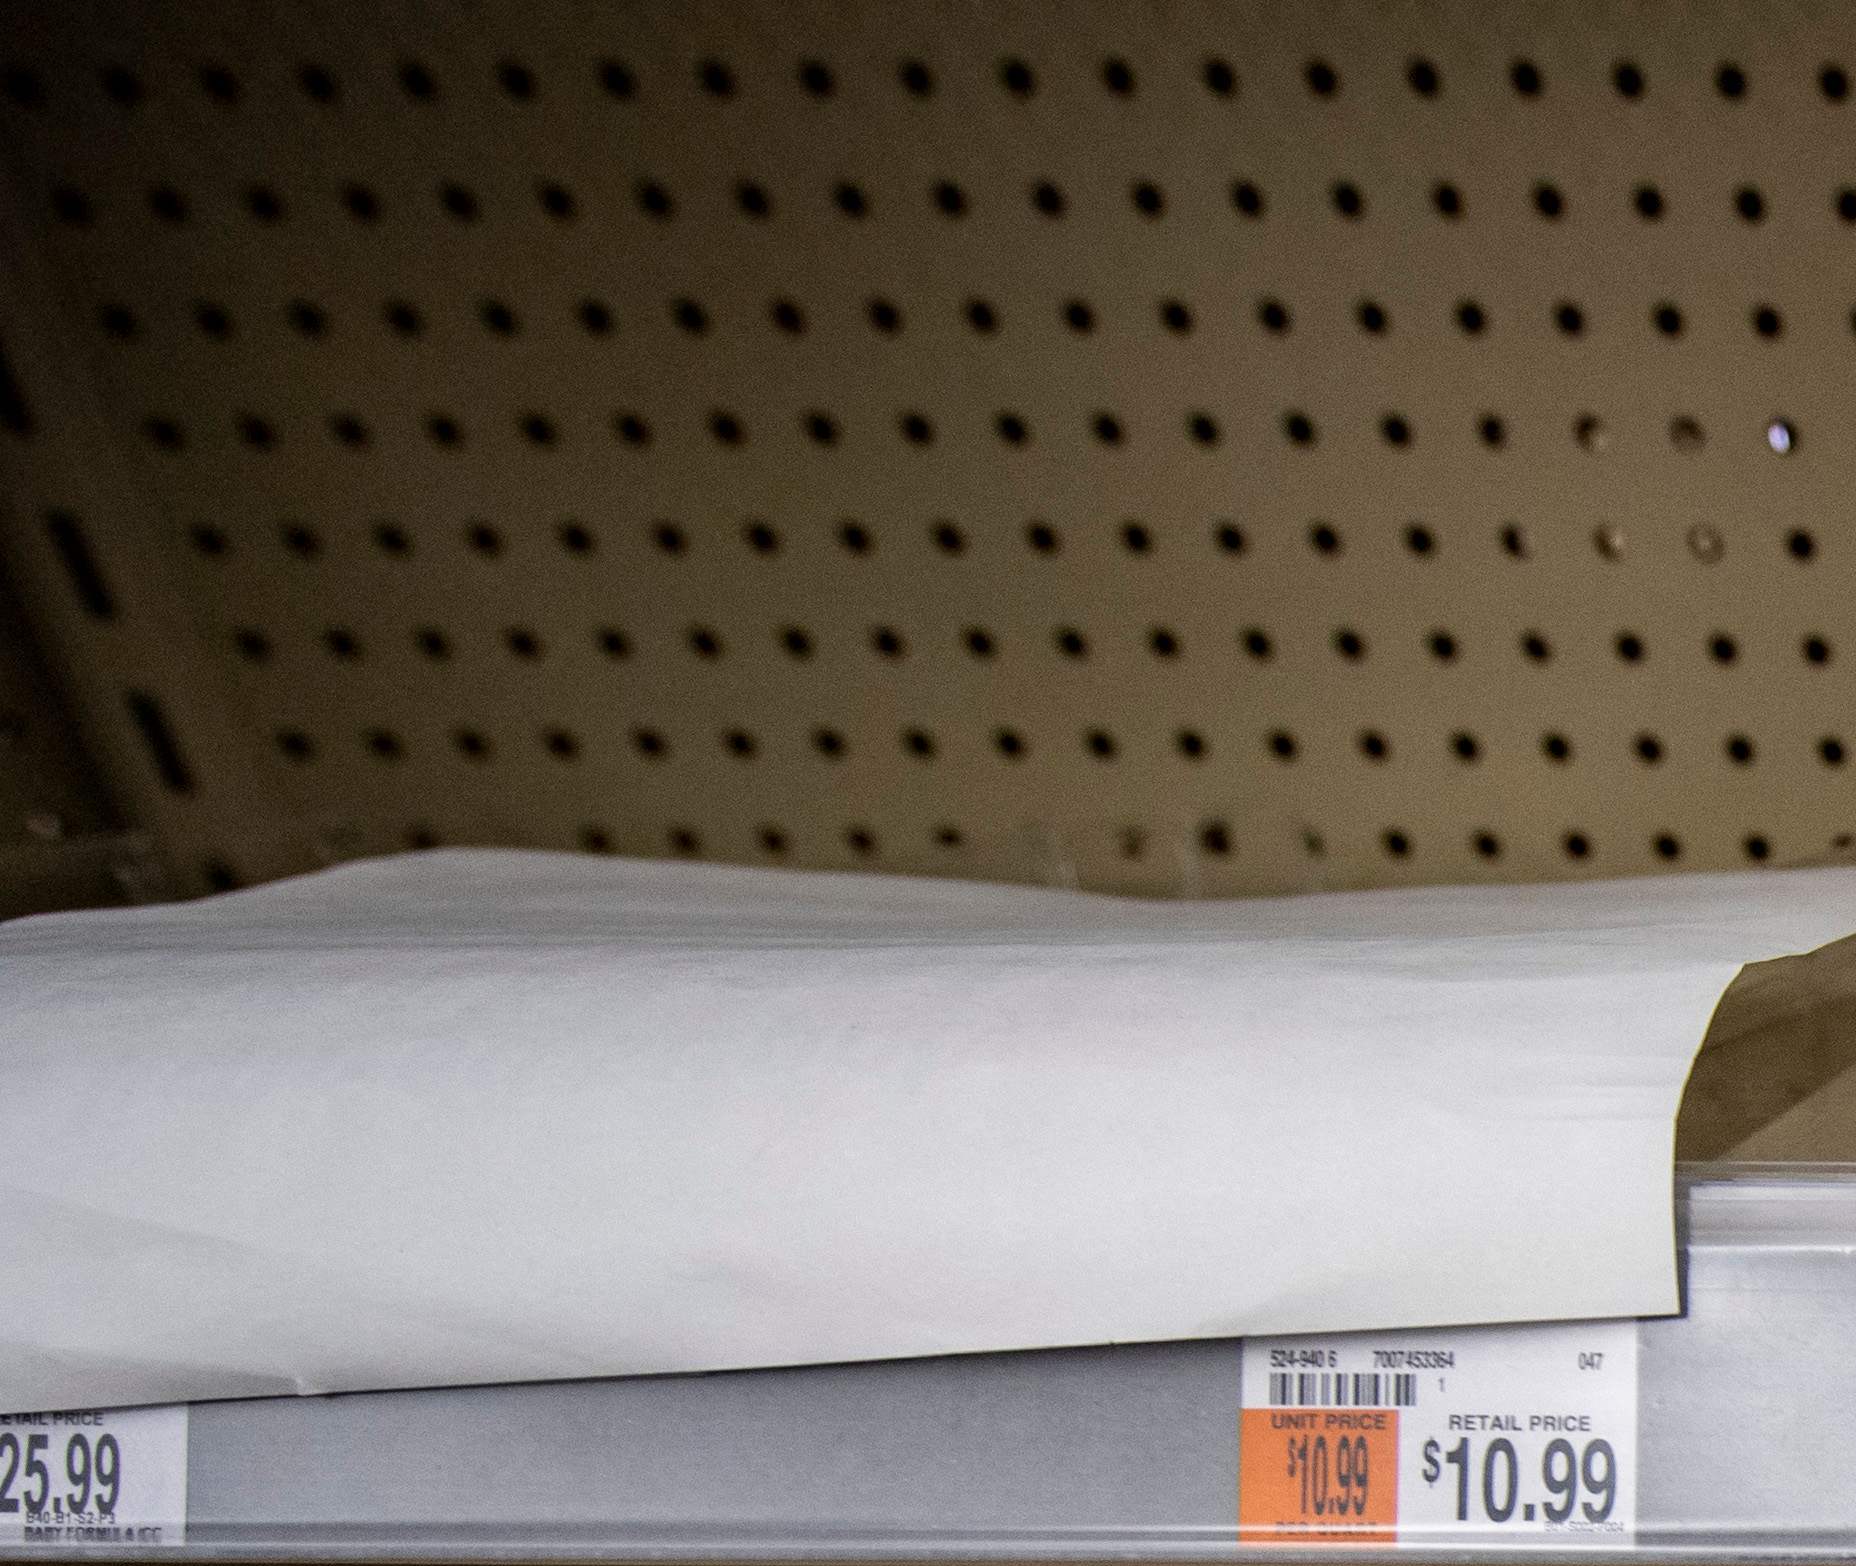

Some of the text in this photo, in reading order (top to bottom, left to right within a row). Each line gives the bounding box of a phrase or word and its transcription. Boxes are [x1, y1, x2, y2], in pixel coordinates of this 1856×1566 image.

[1449, 1415, 1591, 1431] RETAIL PRICE
[1287, 1434, 1369, 1516] $10.99
[1421, 1436, 1618, 1523] $10.99
